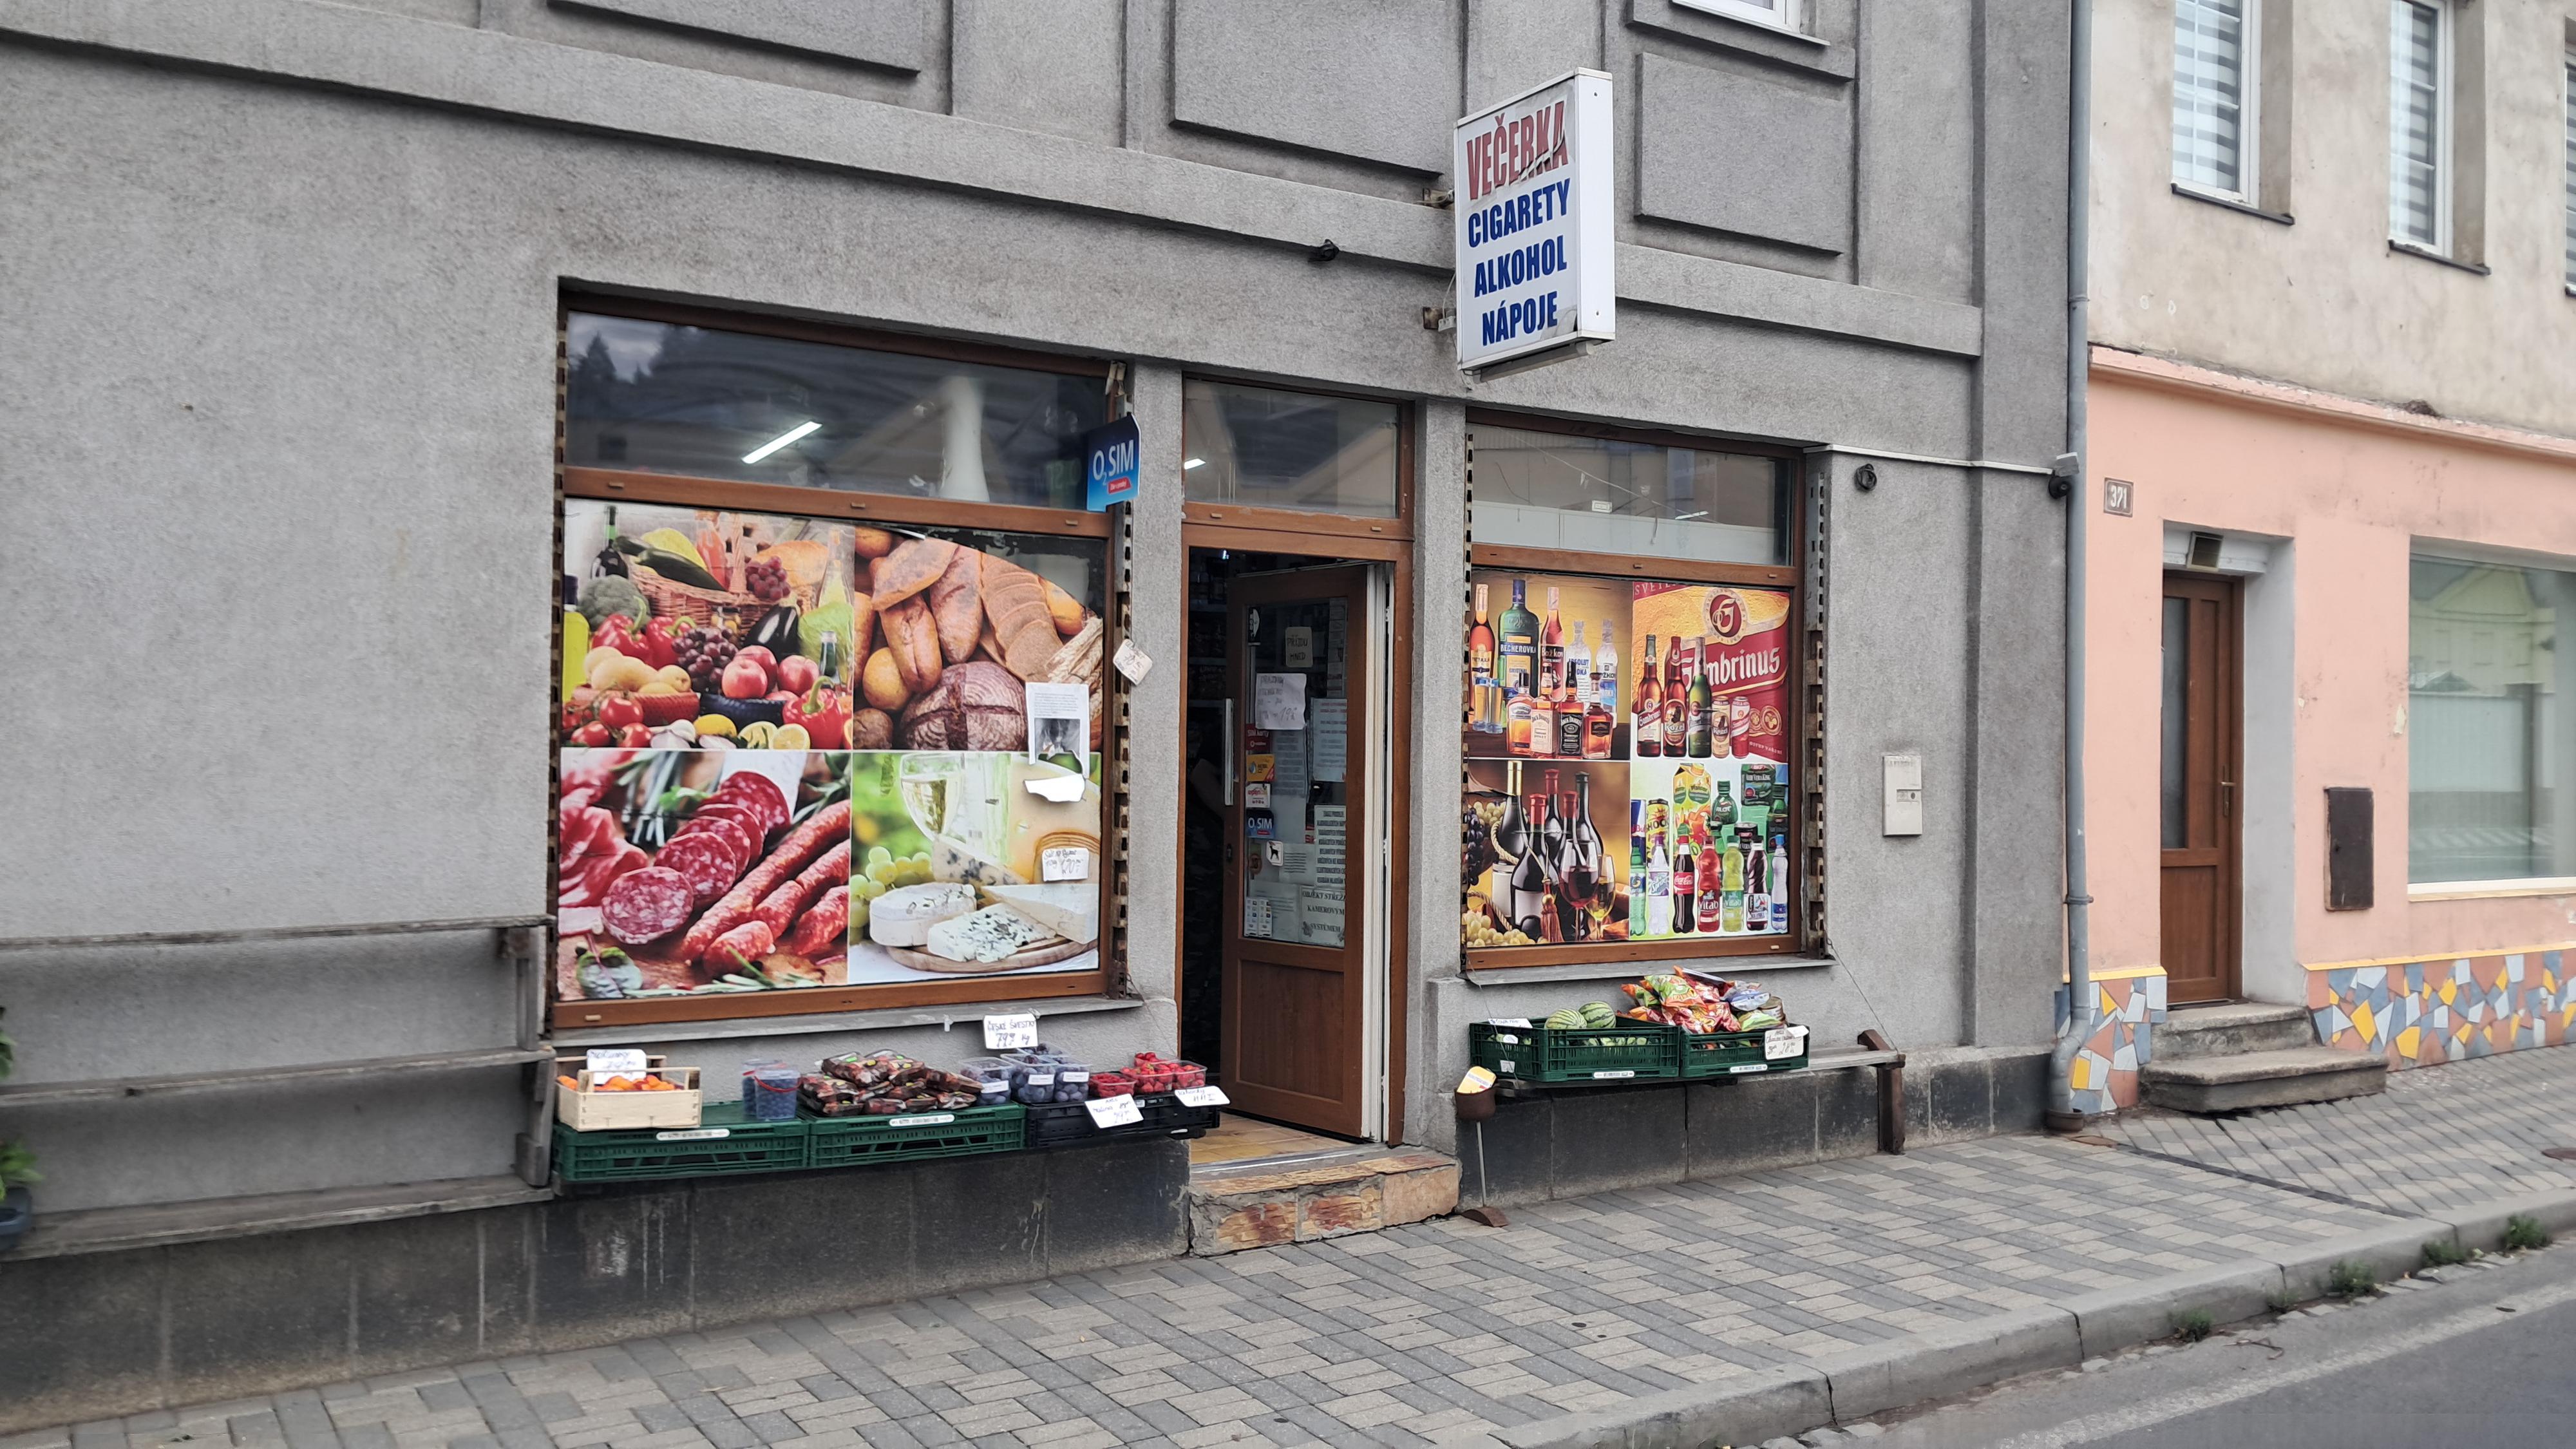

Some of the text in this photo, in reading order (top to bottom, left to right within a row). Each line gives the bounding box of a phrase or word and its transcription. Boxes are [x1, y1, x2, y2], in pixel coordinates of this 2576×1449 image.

[1466, 101, 1569, 200] VEČERKA
[1468, 178, 1571, 248] CIGARETY
[1474, 235, 1567, 298] ALKOHOL
[1482, 291, 1558, 346] NÁPOJE
[1108, 439, 1134, 477] SIM
[2110, 484, 2127, 509] 371
[1500, 644, 1537, 654] BECHEROVKA
[1681, 647, 1781, 692] Gmbrinus
[1257, 818, 1273, 829] SIM
[1302, 891, 1345, 902] OBJEKT STŘEŽ
